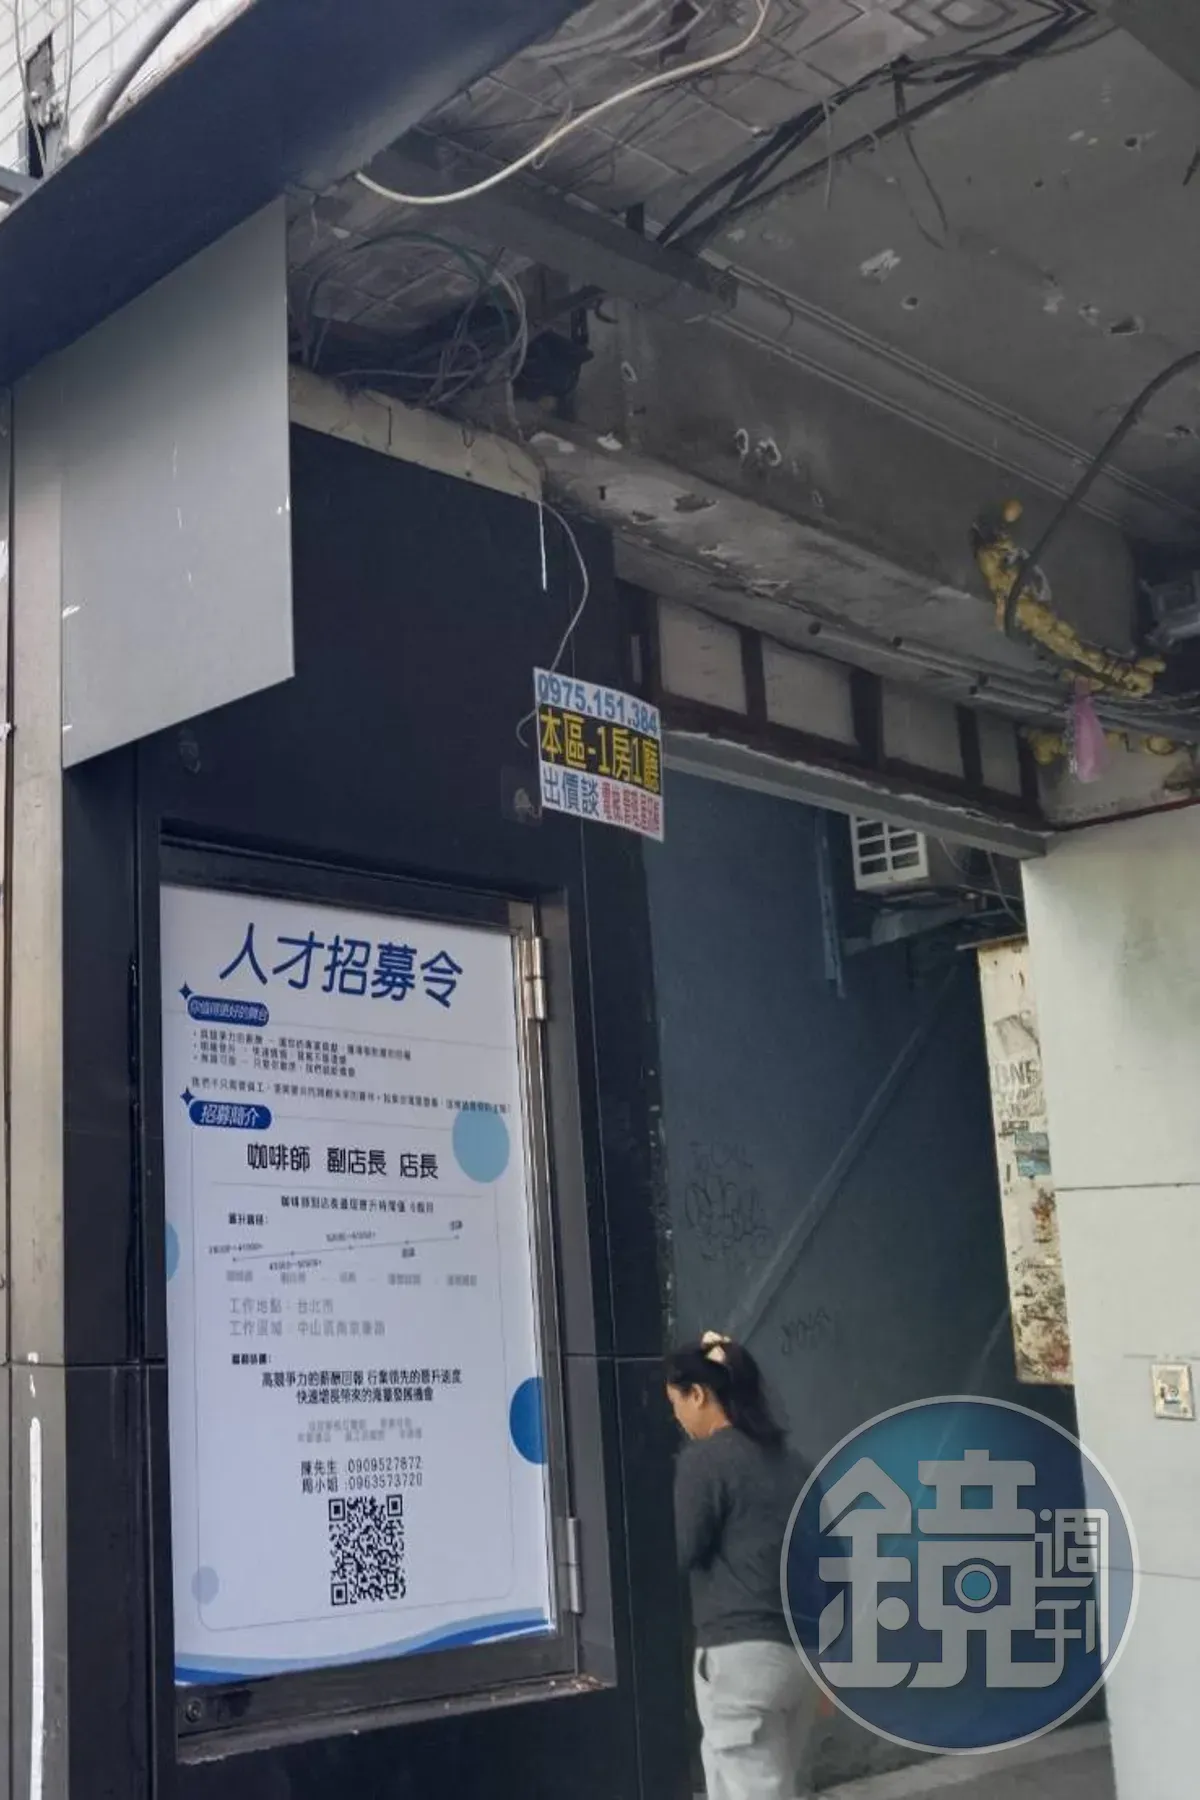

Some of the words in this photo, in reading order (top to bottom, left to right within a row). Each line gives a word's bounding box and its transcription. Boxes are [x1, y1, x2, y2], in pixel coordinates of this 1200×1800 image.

[219, 922, 463, 1009] 人才招募令
[201, 1105, 260, 1127] 招募簡介
[247, 1142, 311, 1173] 咖啡師
[327, 1145, 387, 1177] 副店長
[400, 1153, 439, 1180] 店長
